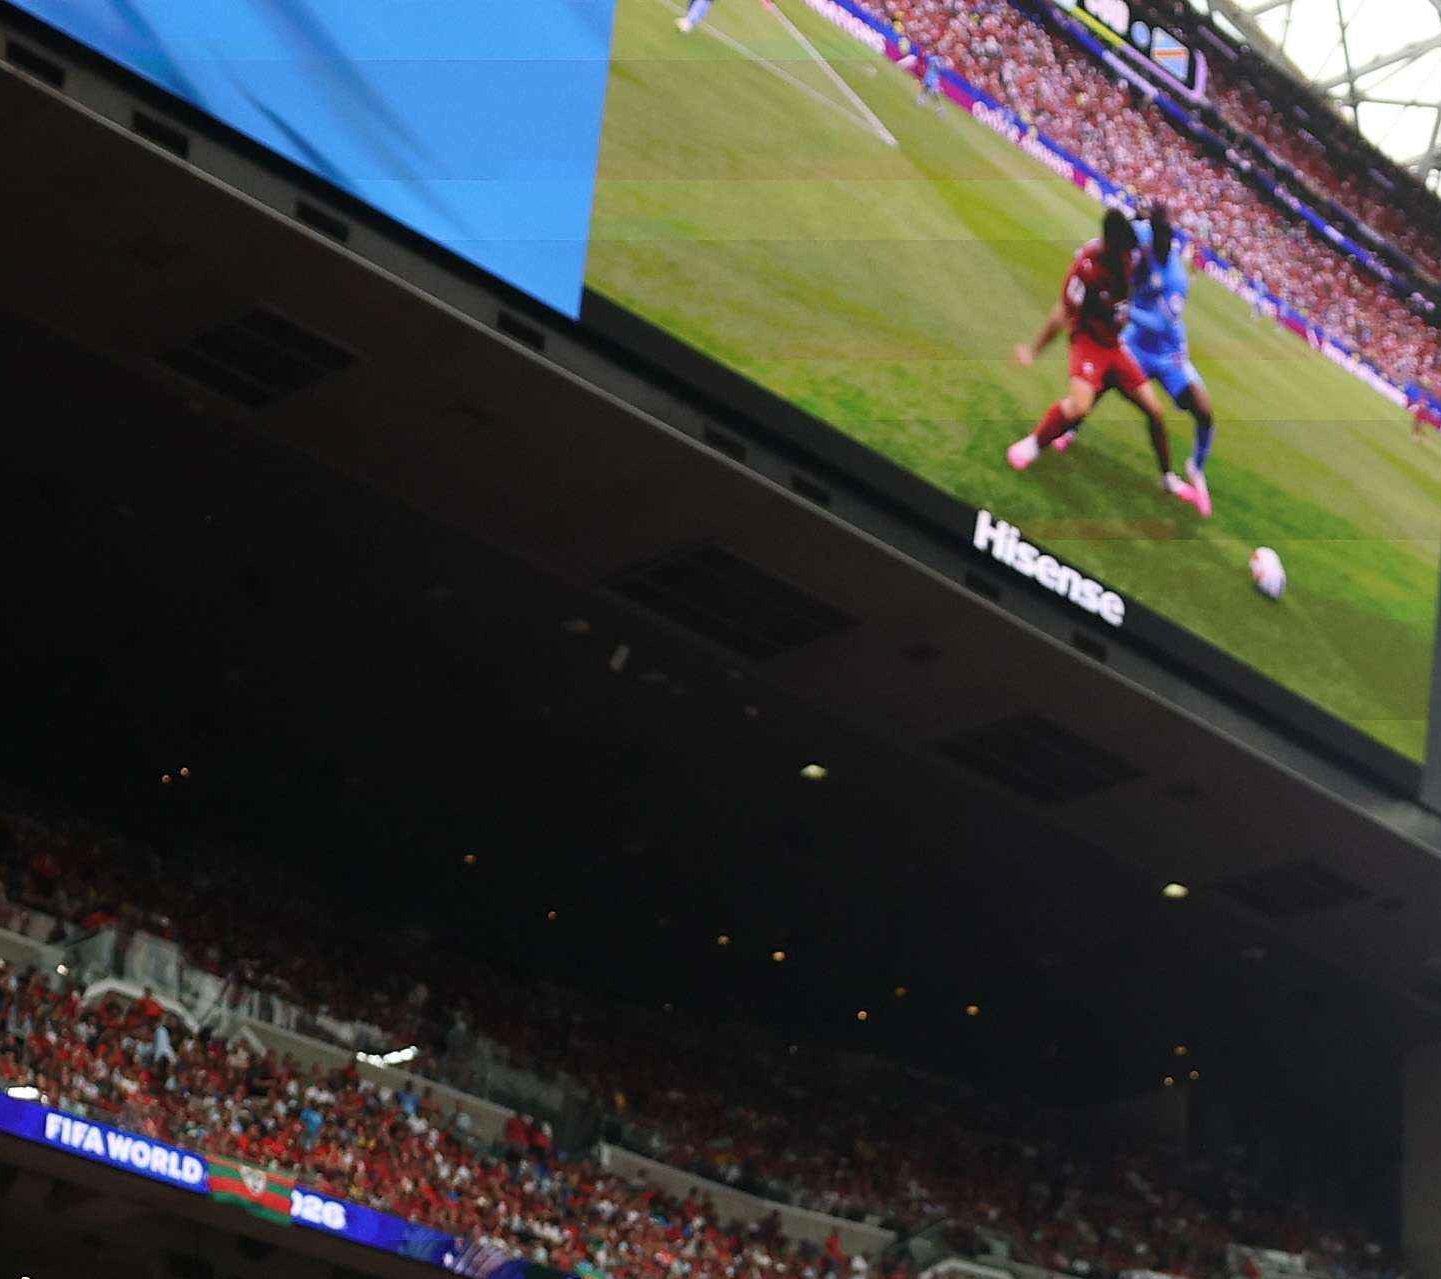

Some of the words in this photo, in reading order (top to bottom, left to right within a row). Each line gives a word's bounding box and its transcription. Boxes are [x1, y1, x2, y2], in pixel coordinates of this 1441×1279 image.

[973, 509, 1126, 628] Hisense
[45, 1111, 104, 1156] FIFA
[106, 1130, 205, 1185] WORLD
